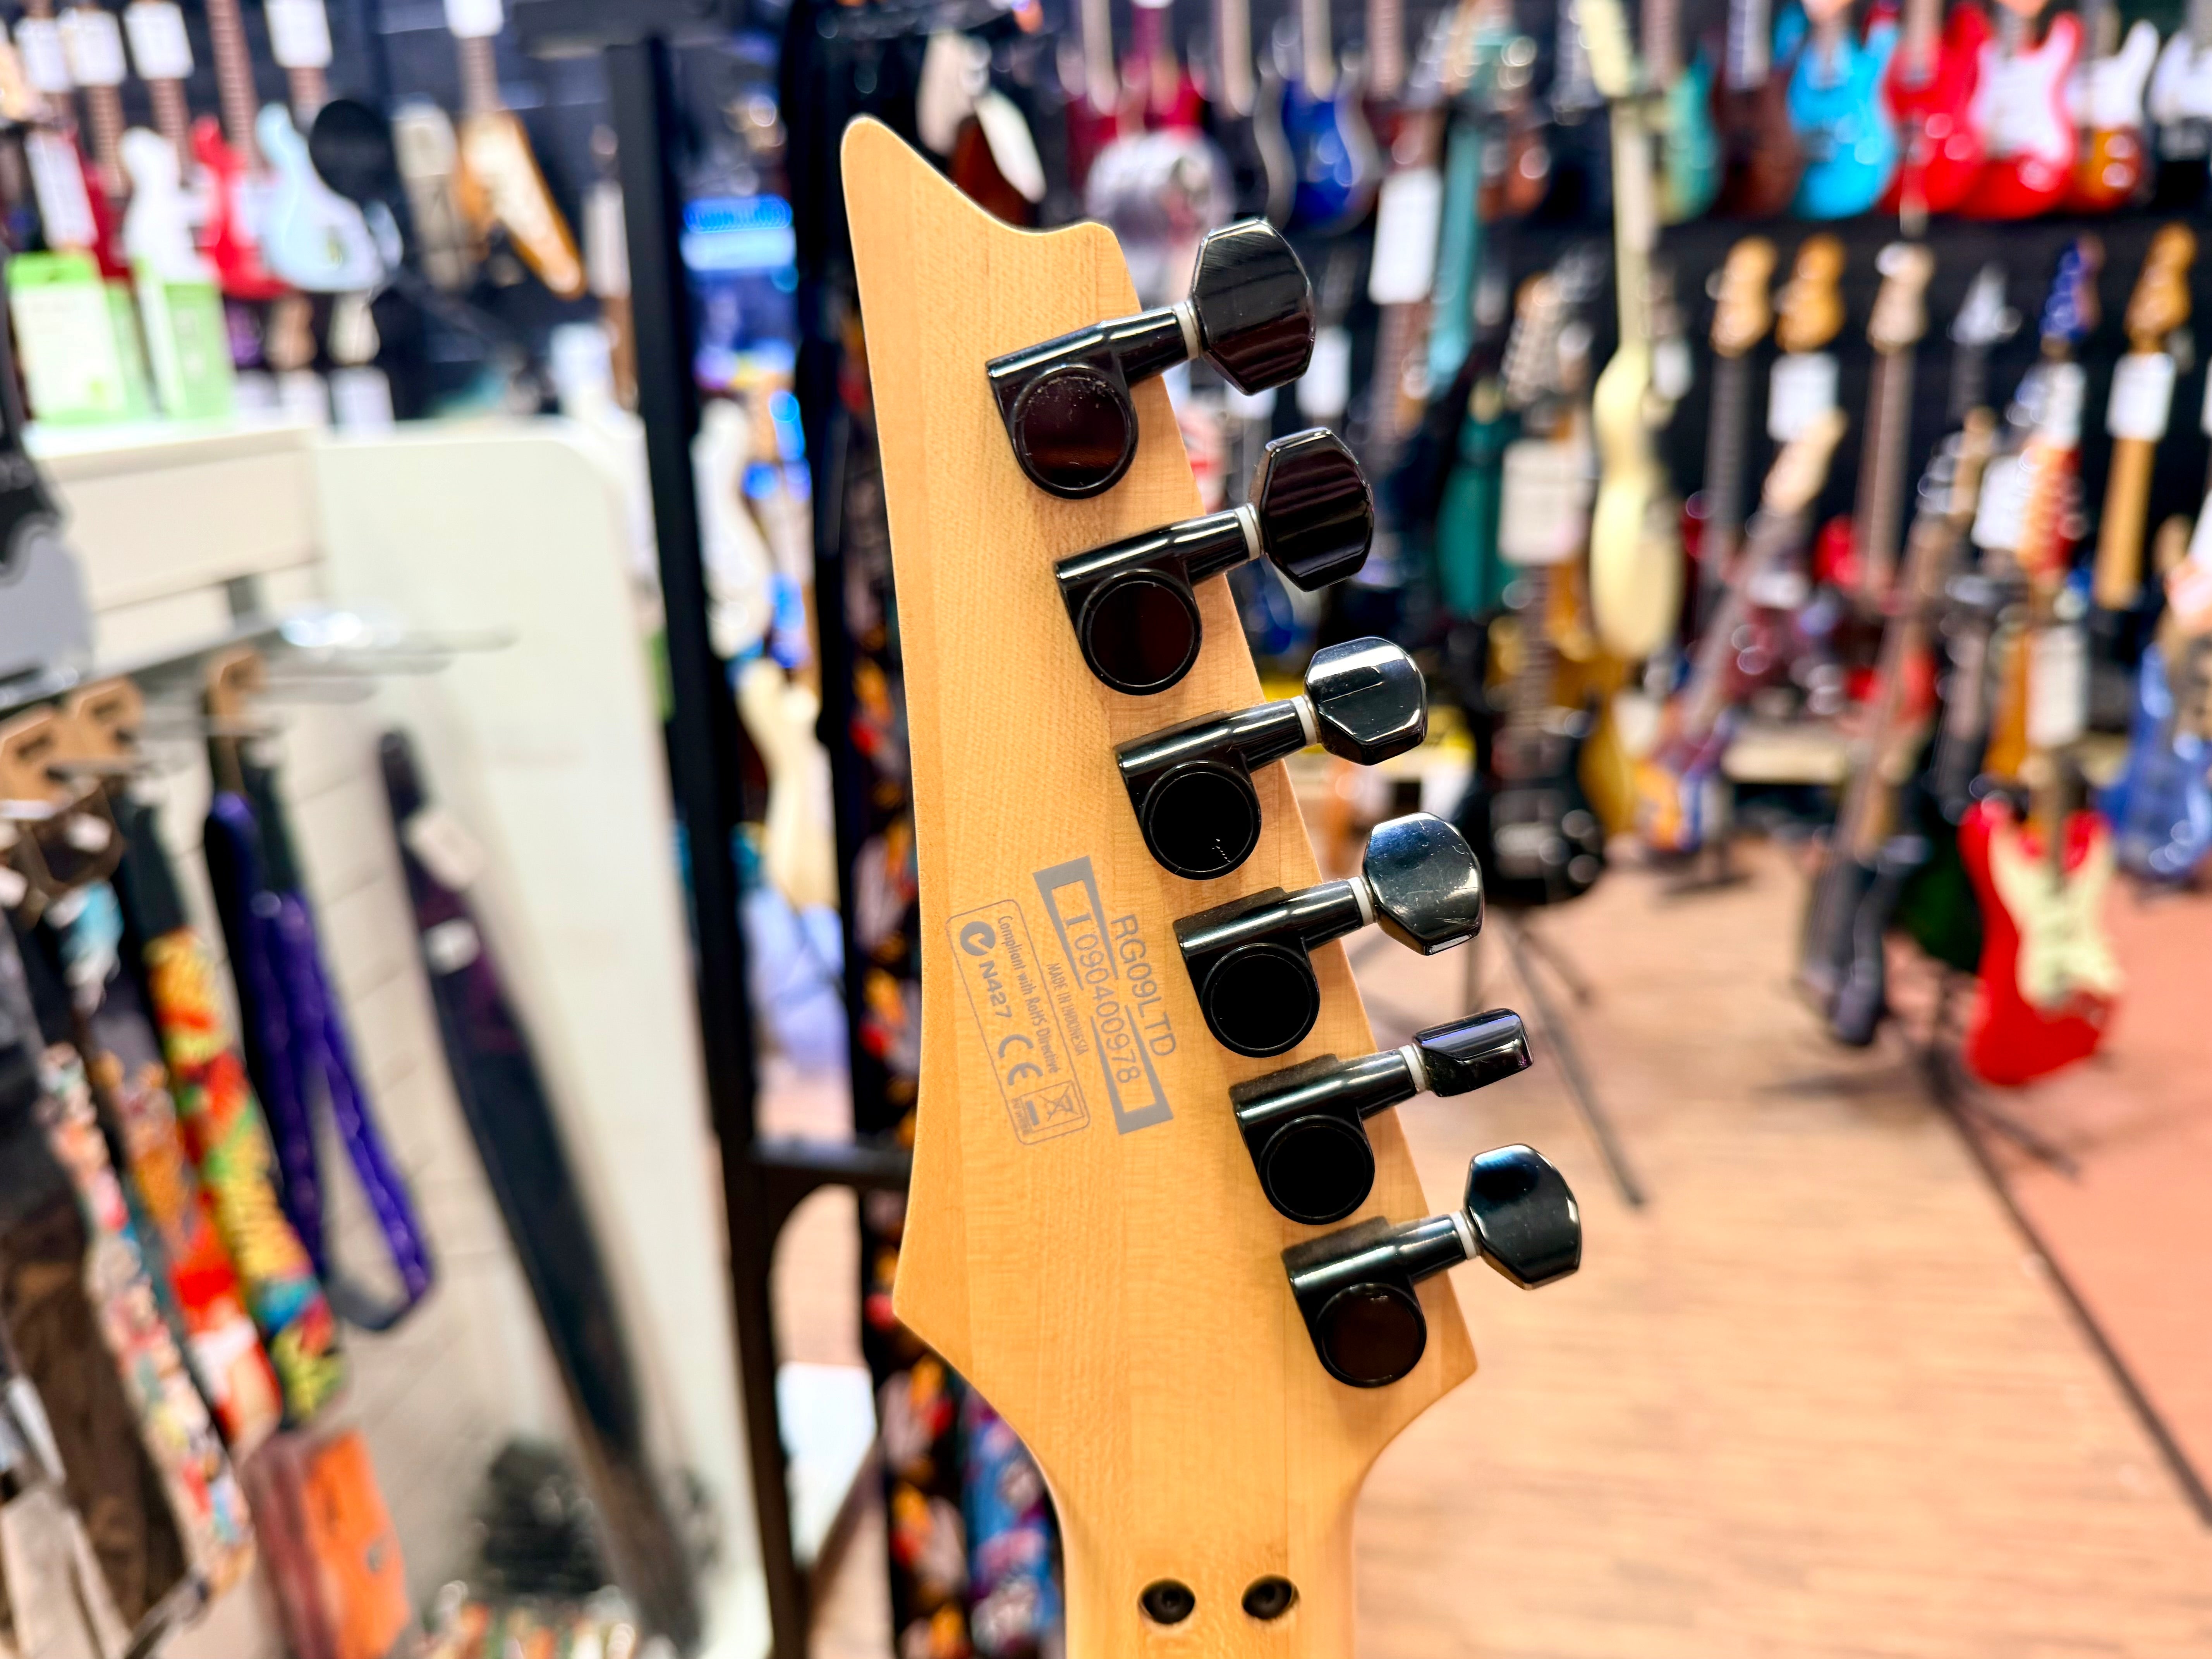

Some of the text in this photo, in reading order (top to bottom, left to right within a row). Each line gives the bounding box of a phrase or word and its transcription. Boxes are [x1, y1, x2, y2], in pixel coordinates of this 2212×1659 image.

[979, 960, 1012, 1018] N427
[997, 915, 1060, 1074] Compliant with RoHS Directive
[1047, 962, 1089, 1055] MADE IN INDONESIA
[1111, 914, 1176, 1056] RG09LTD
[998, 1034, 1043, 1085] CE
